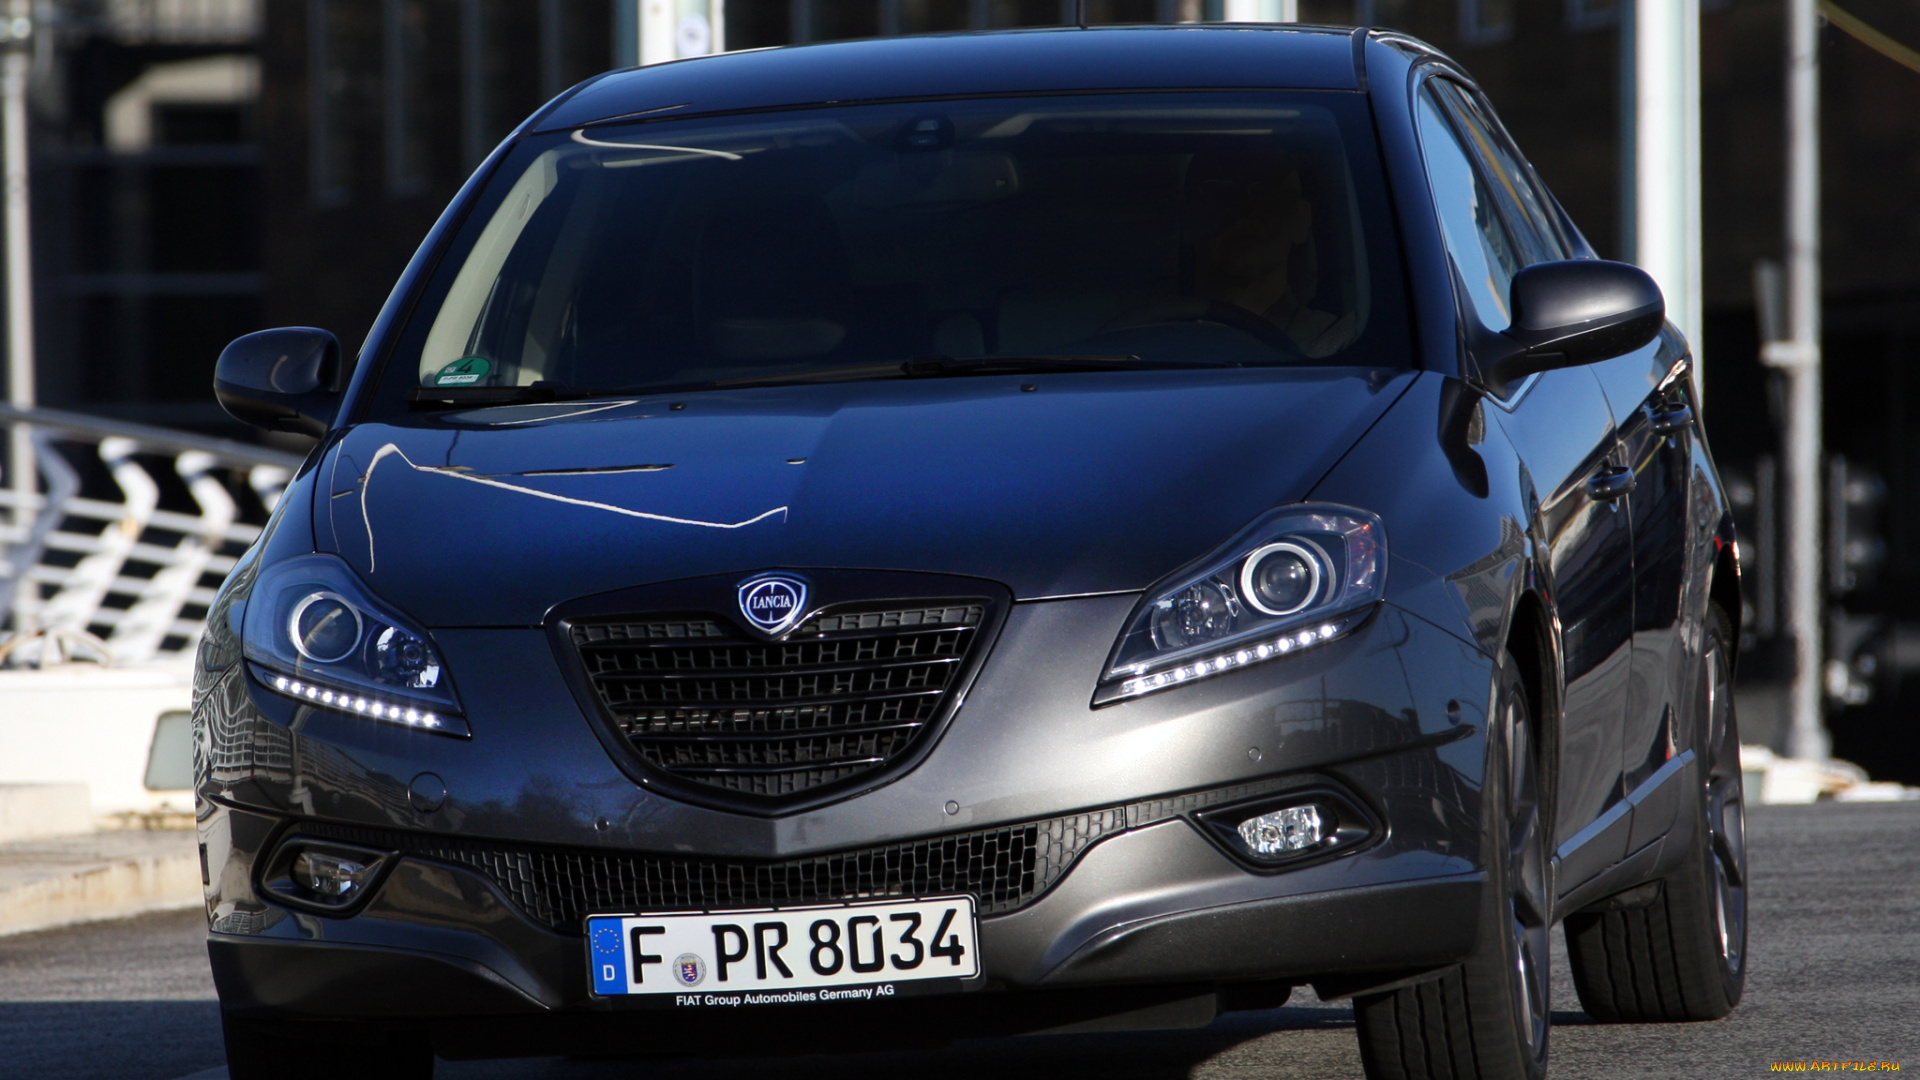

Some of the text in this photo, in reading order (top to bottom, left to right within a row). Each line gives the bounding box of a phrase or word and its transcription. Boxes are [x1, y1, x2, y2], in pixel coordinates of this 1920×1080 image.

[457, 359, 474, 373] 4
[753, 595, 792, 609] LANCIA
[630, 925, 666, 984] F
[711, 920, 793, 982] PR
[809, 908, 965, 977] 8034
[603, 965, 615, 981] D
[676, 984, 894, 1007] FIAT Group Automobiles Germany AG
